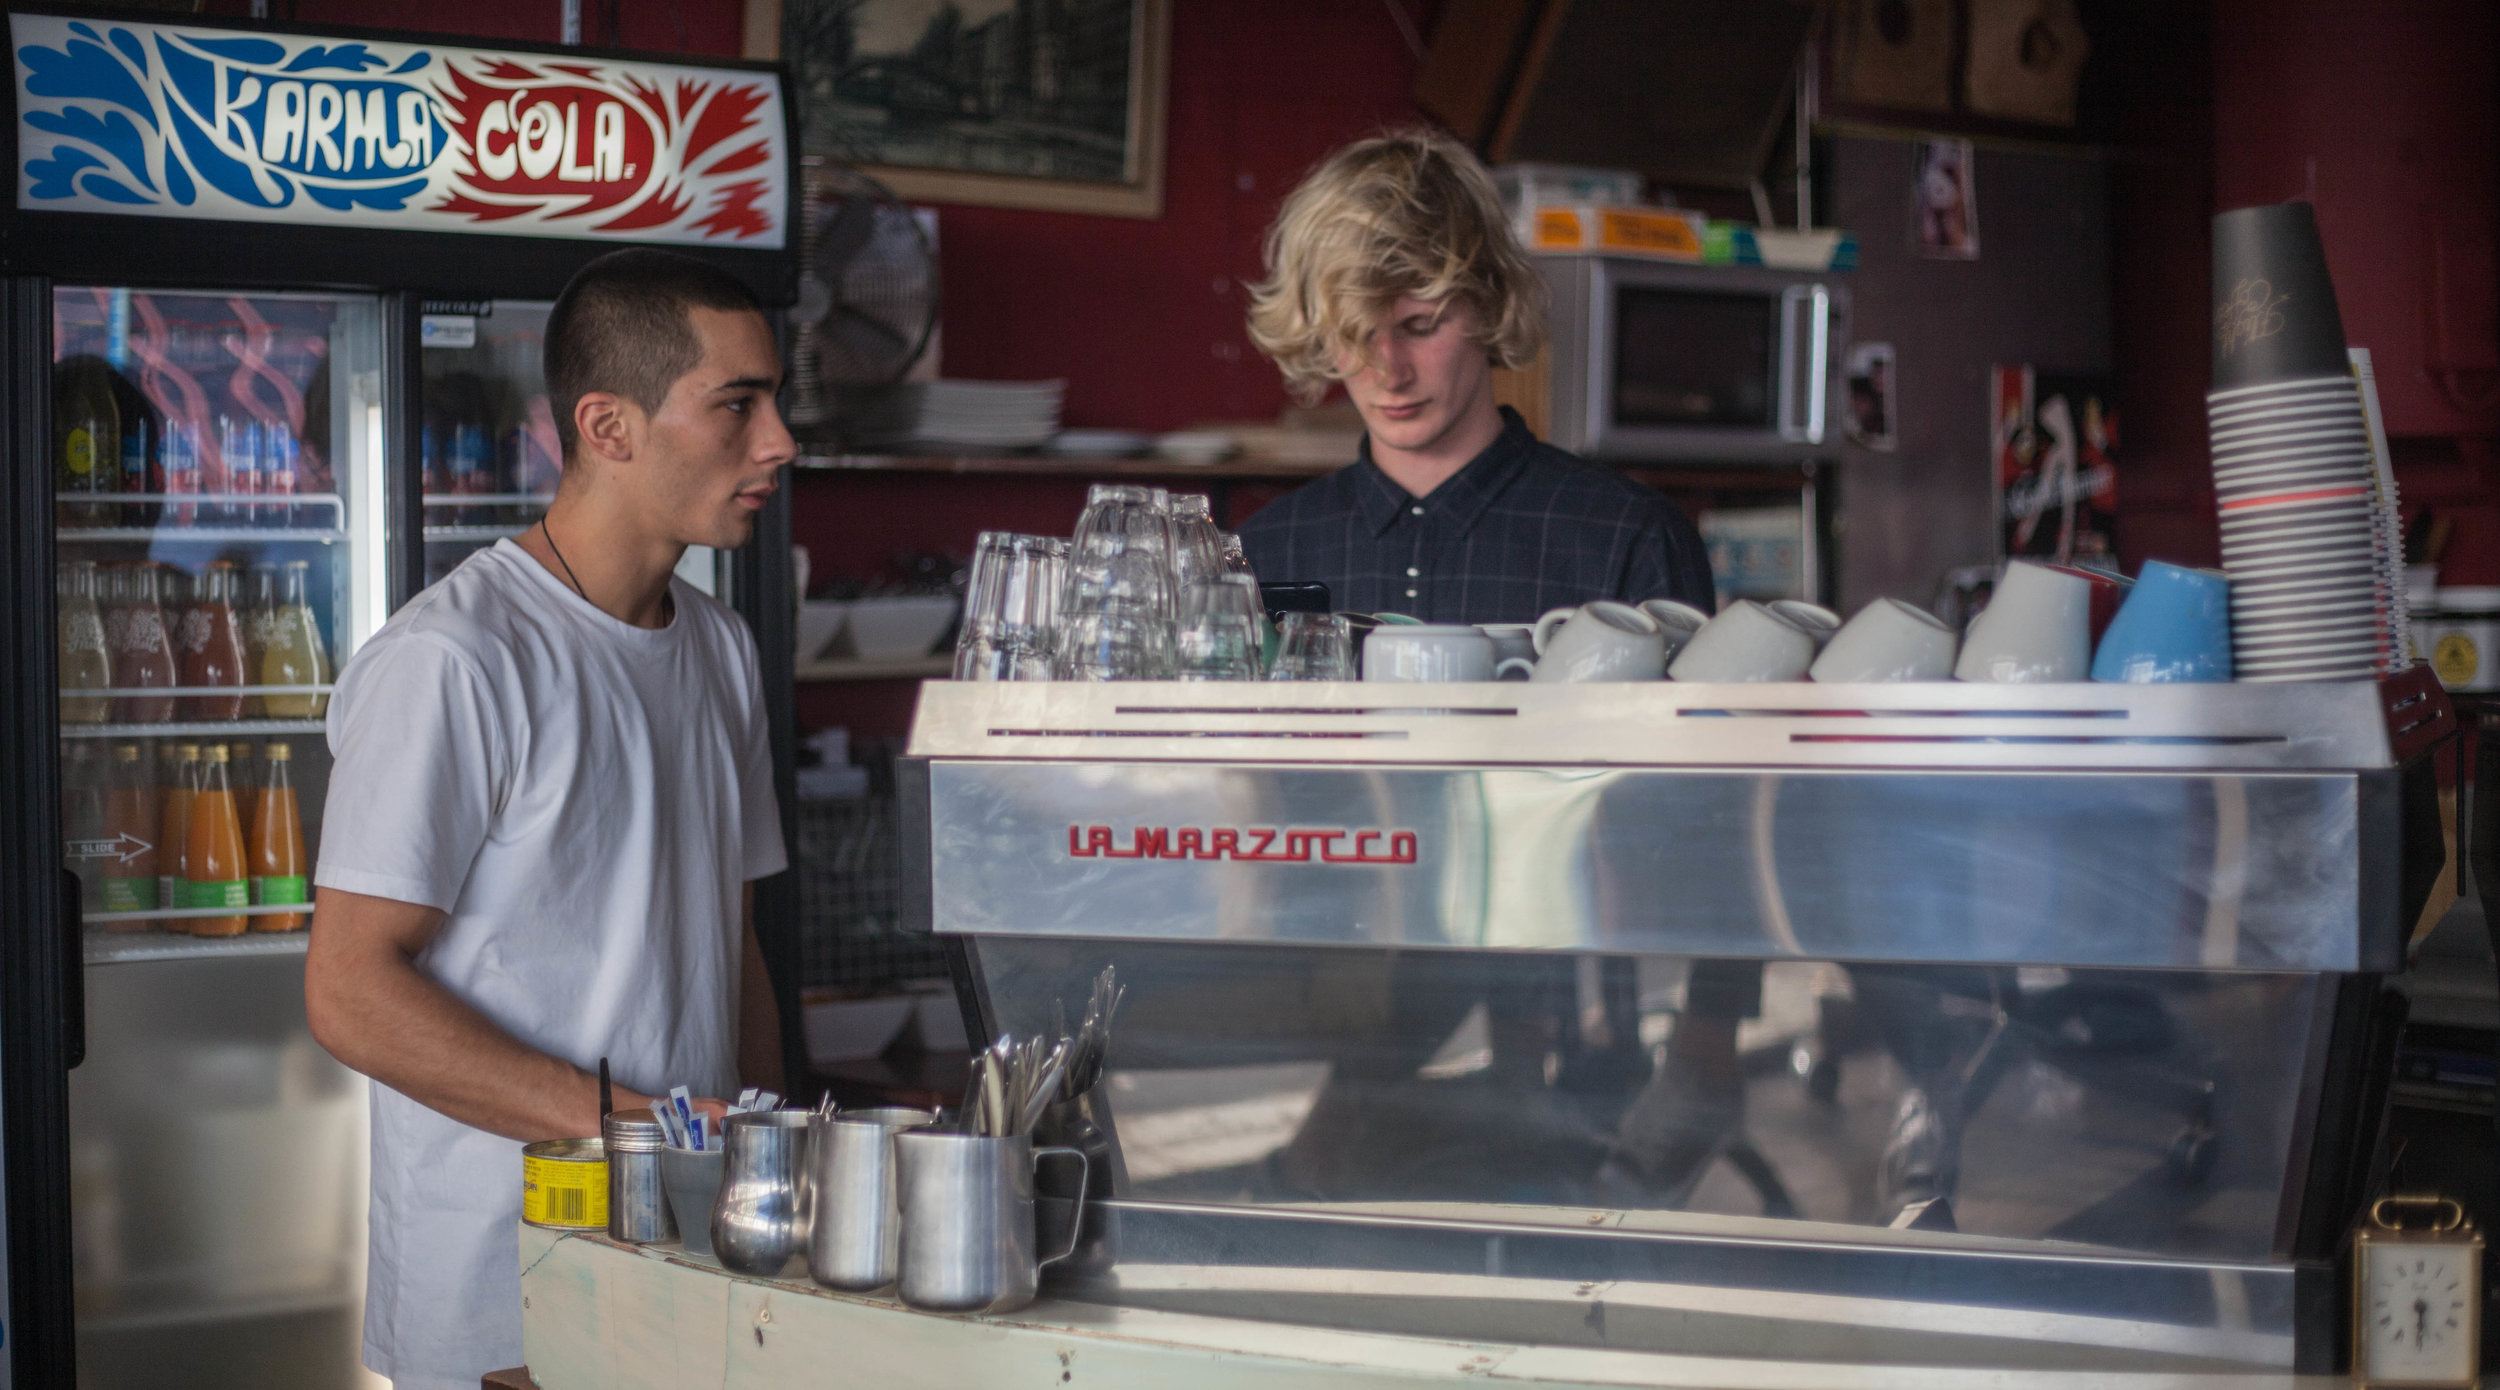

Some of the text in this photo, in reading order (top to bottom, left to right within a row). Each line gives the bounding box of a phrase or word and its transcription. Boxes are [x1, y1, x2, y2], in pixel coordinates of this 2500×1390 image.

[213, 62, 625, 182] KARMA COLA
[81, 843, 116, 853] SLIDE
[1069, 825, 1417, 864] LA MARZOCCO
